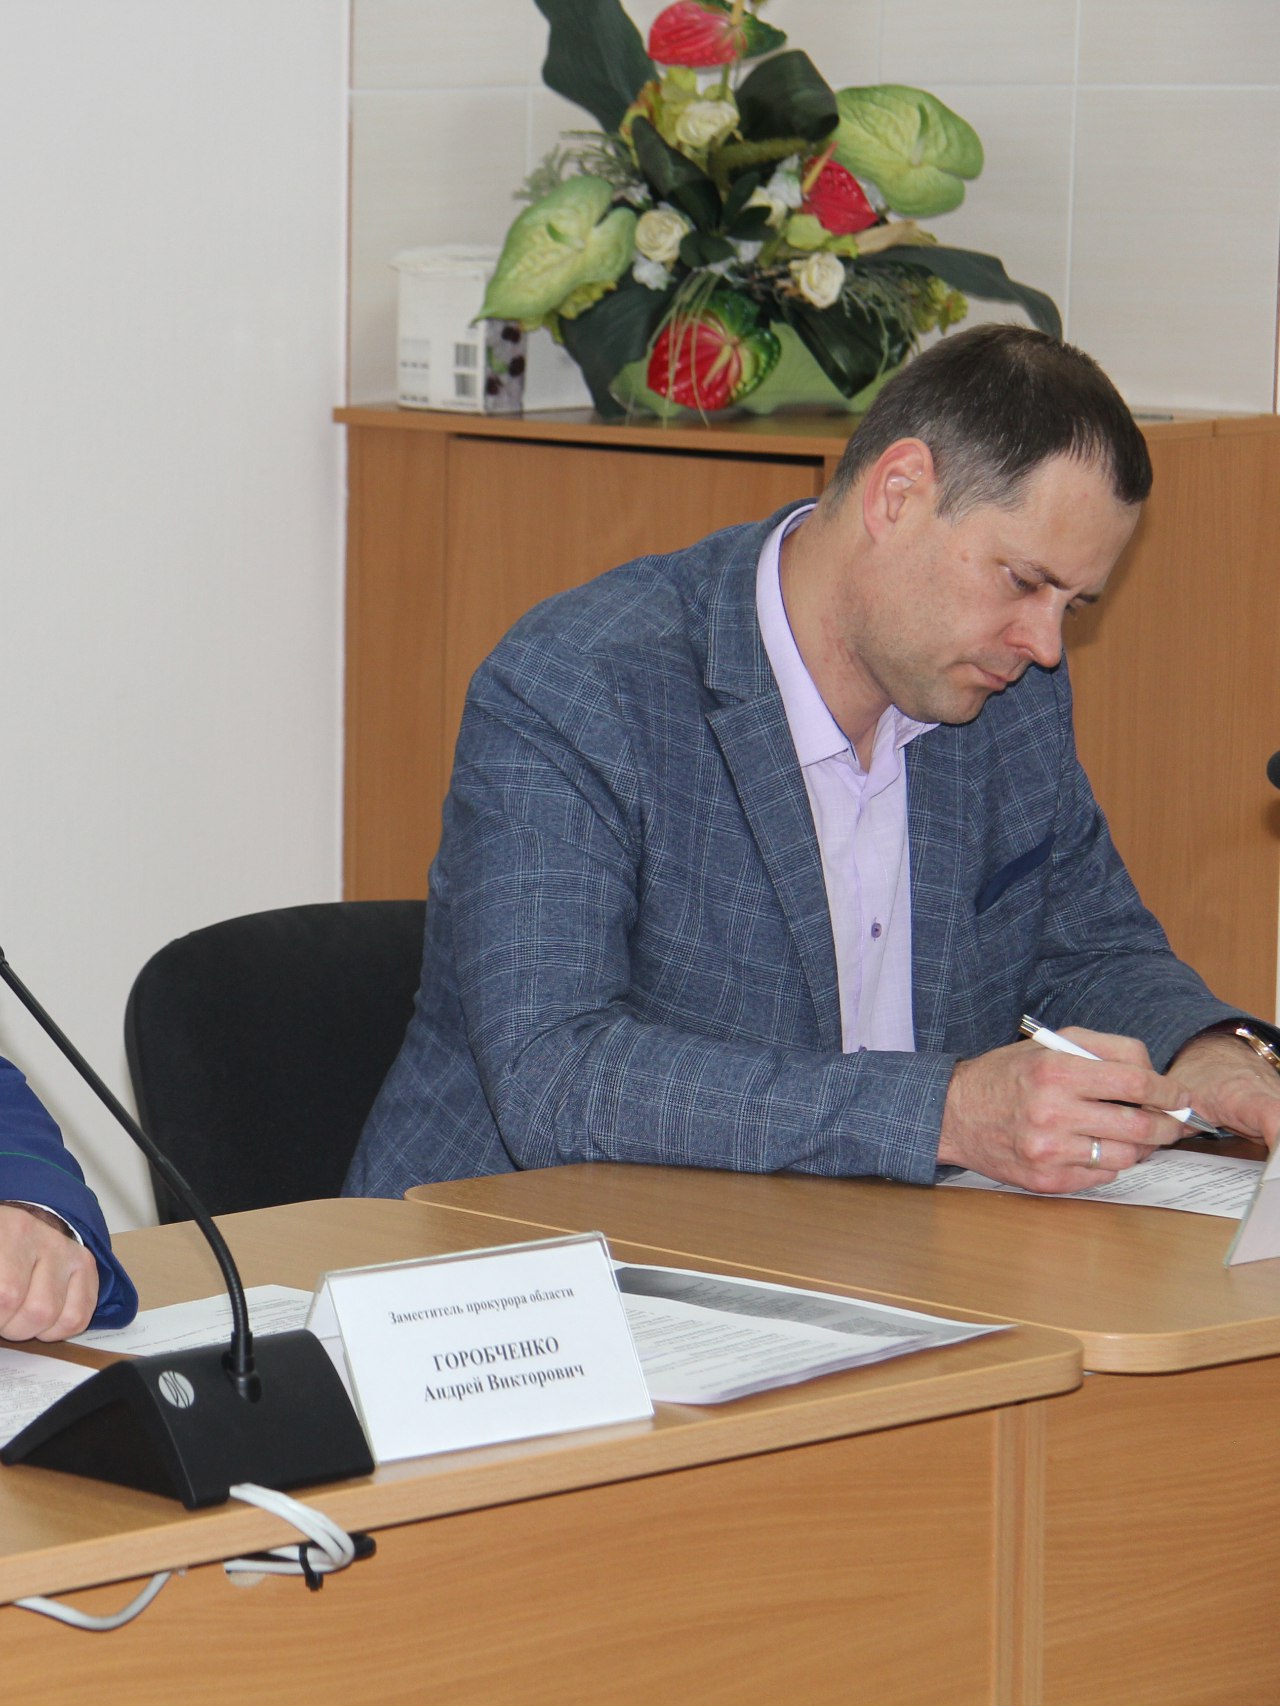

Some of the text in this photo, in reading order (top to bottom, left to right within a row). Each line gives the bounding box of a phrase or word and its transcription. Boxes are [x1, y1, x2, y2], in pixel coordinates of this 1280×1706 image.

[388, 1288, 575, 1325] Заместитель прокурора области
[432, 1336, 560, 1372] ГОРОБЧЕНКО
[424, 1363, 585, 1402] Андрей Викторович
